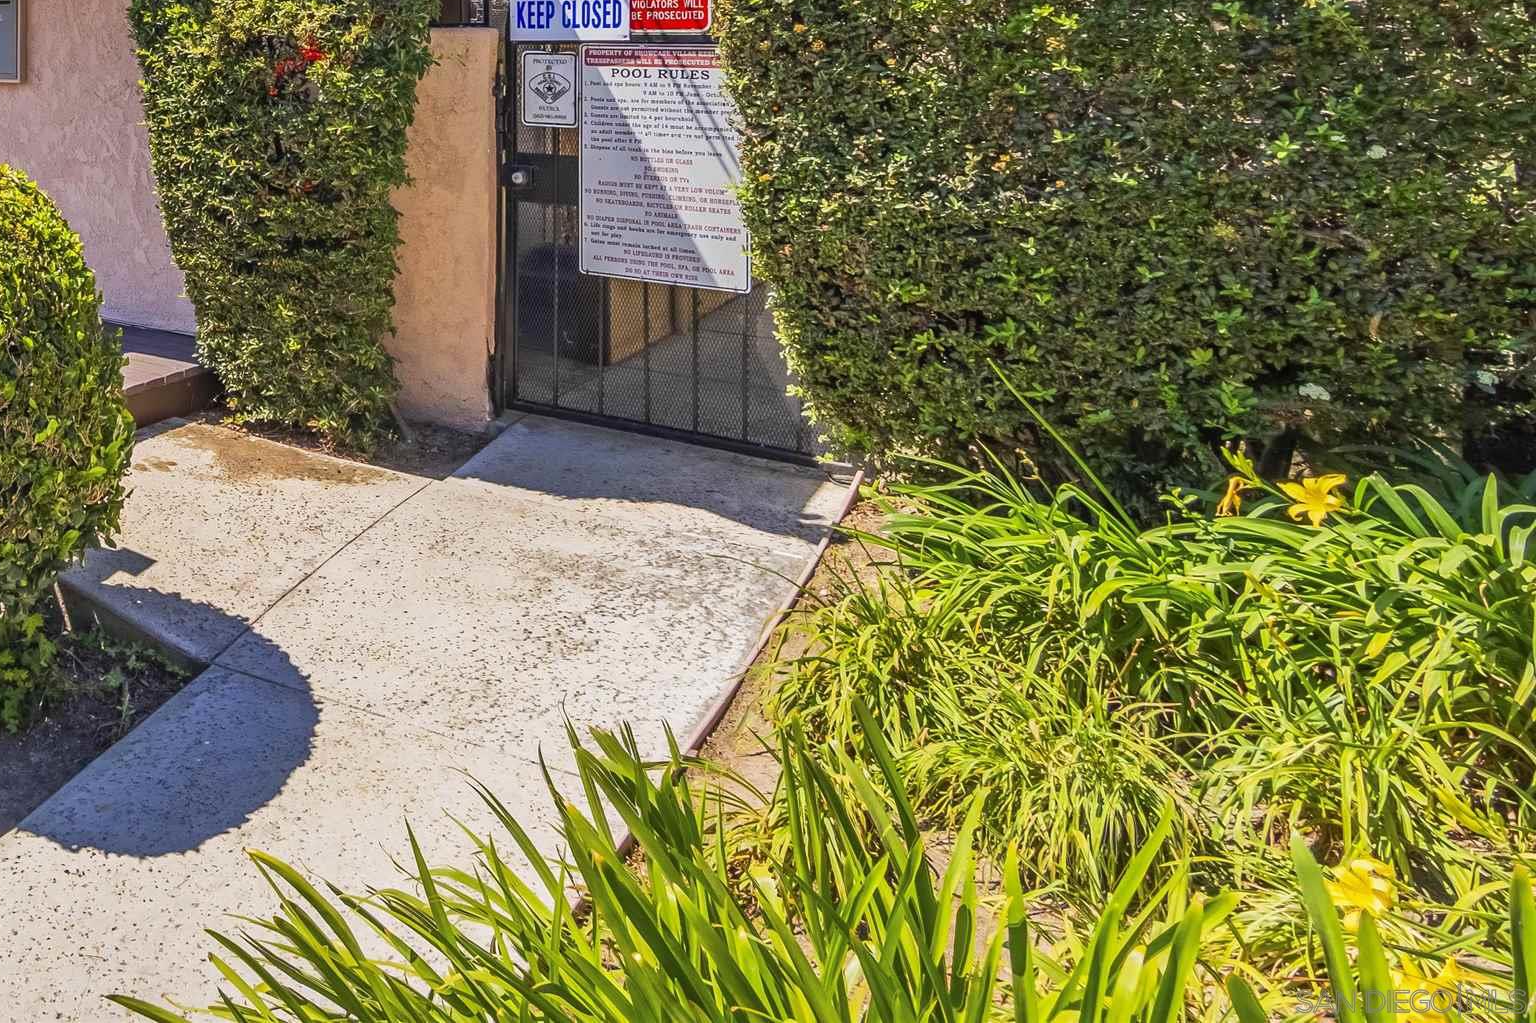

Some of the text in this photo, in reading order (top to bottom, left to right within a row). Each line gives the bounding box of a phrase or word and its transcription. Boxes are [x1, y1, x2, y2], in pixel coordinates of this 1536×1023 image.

[632, 0, 704, 9] VIOLATORS WILL
[517, 0, 622, 28] KEEP CLOSED
[631, 10, 704, 20] BE PROSECUTED
[611, 68, 710, 80] POOL RULES
